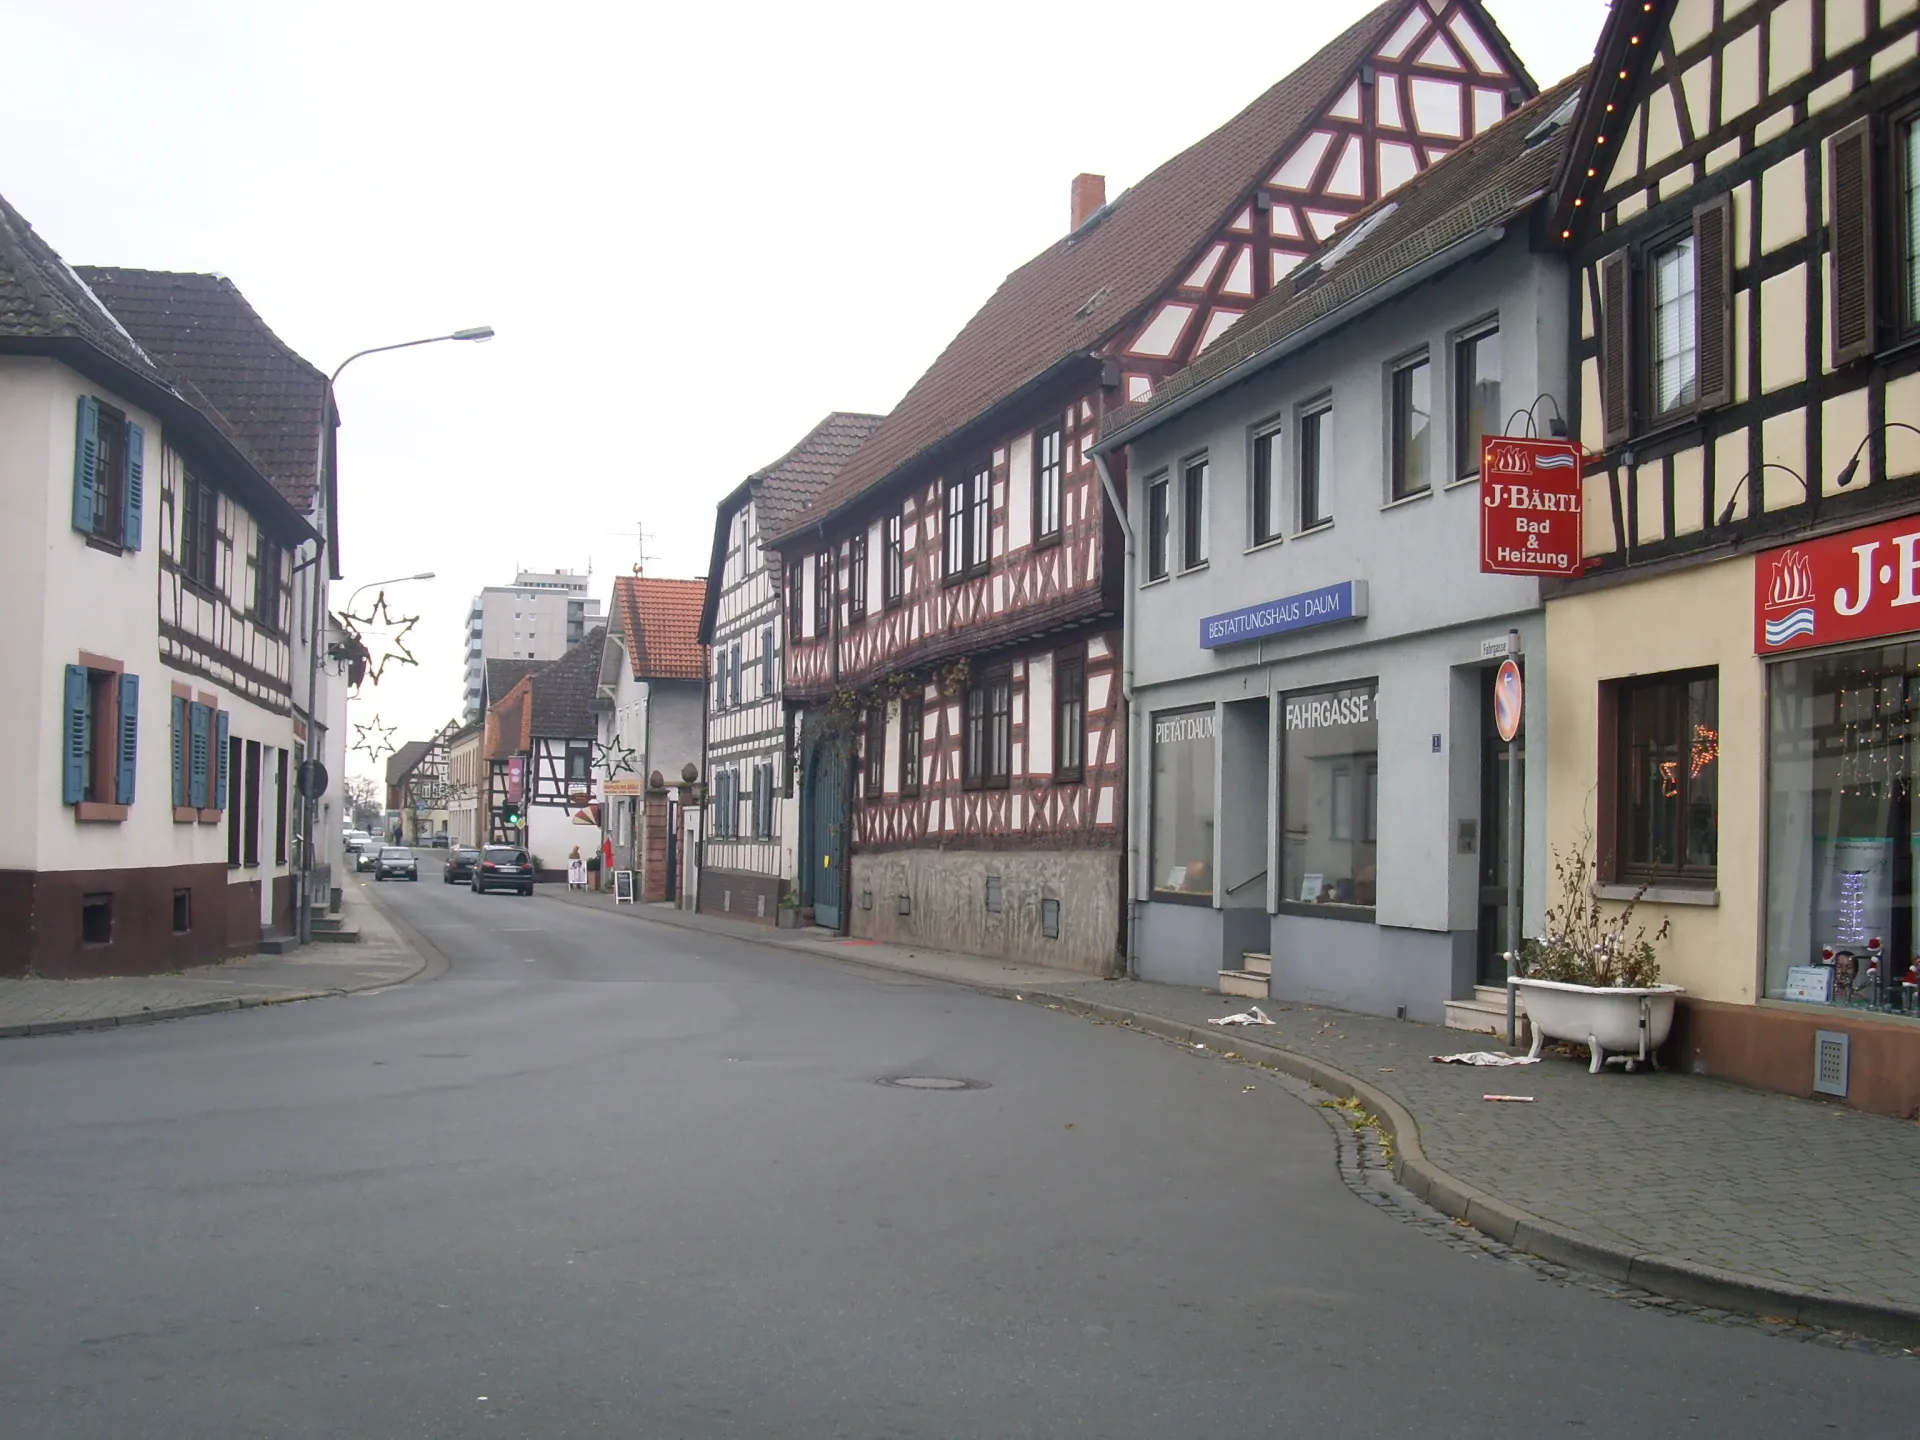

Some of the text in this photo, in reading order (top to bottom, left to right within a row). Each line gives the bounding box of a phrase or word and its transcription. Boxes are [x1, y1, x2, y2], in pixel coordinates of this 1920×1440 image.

[1516, 517, 1550, 534] Bad
[1526, 534, 1539, 549] &
[1497, 546, 1568, 568] Heizung
[1208, 592, 1340, 639] BESTATTUNGSHAUS DAUM
[1483, 642, 1507, 657] Fahrgasse
[1285, 694, 1369, 730] FAHRGASSE
[1155, 715, 1216, 744] PIETÄT DAUM
